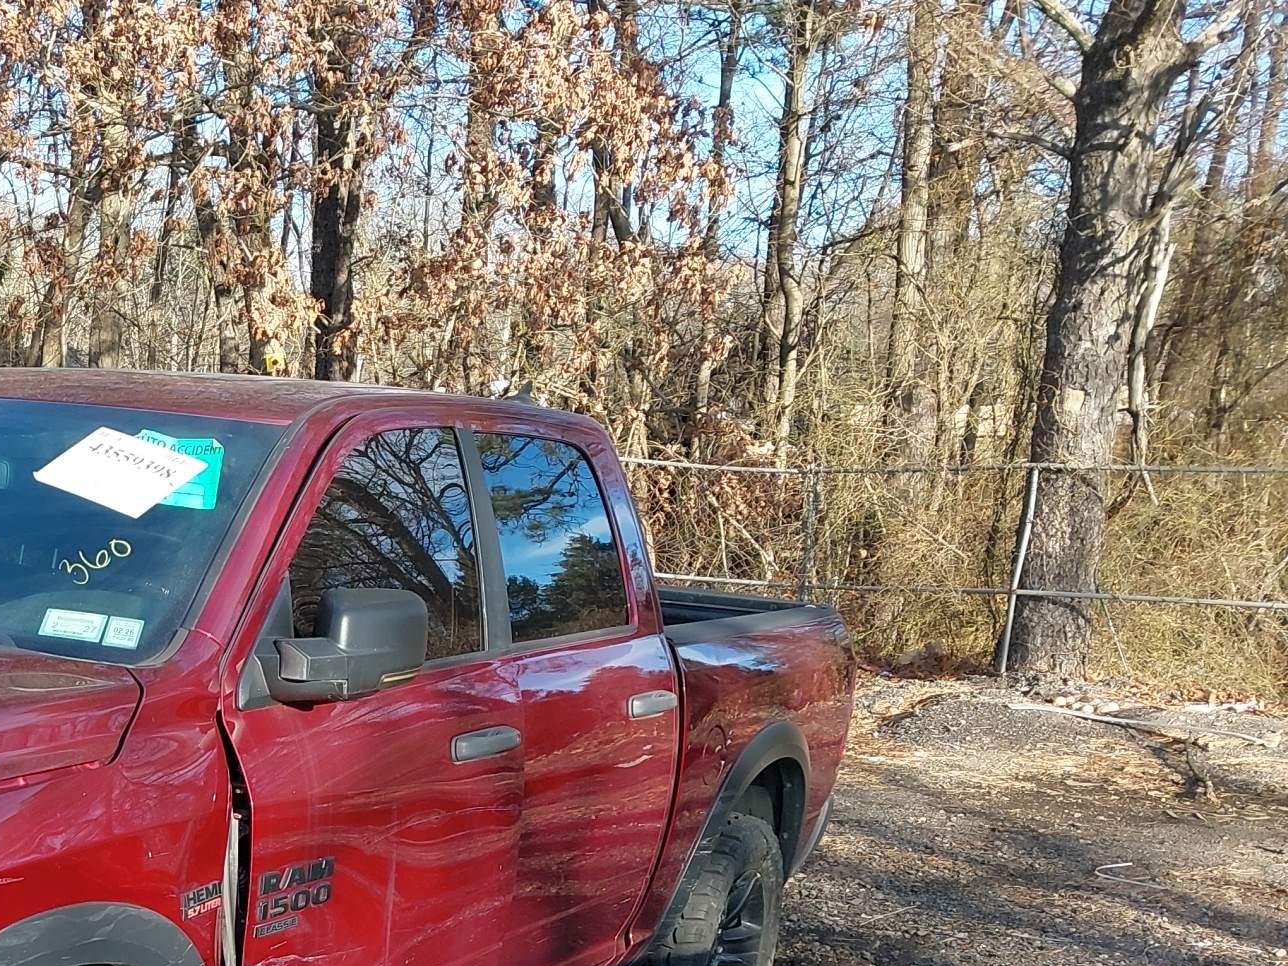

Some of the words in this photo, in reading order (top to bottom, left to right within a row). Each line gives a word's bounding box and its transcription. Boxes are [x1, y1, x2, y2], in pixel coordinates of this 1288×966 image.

[88, 441, 177, 480] 43559398
[169, 443, 224, 457] ACCIDENT
[58, 539, 132, 585] 360
[258, 856, 336, 895] RAM
[257, 882, 332, 921] 1500
